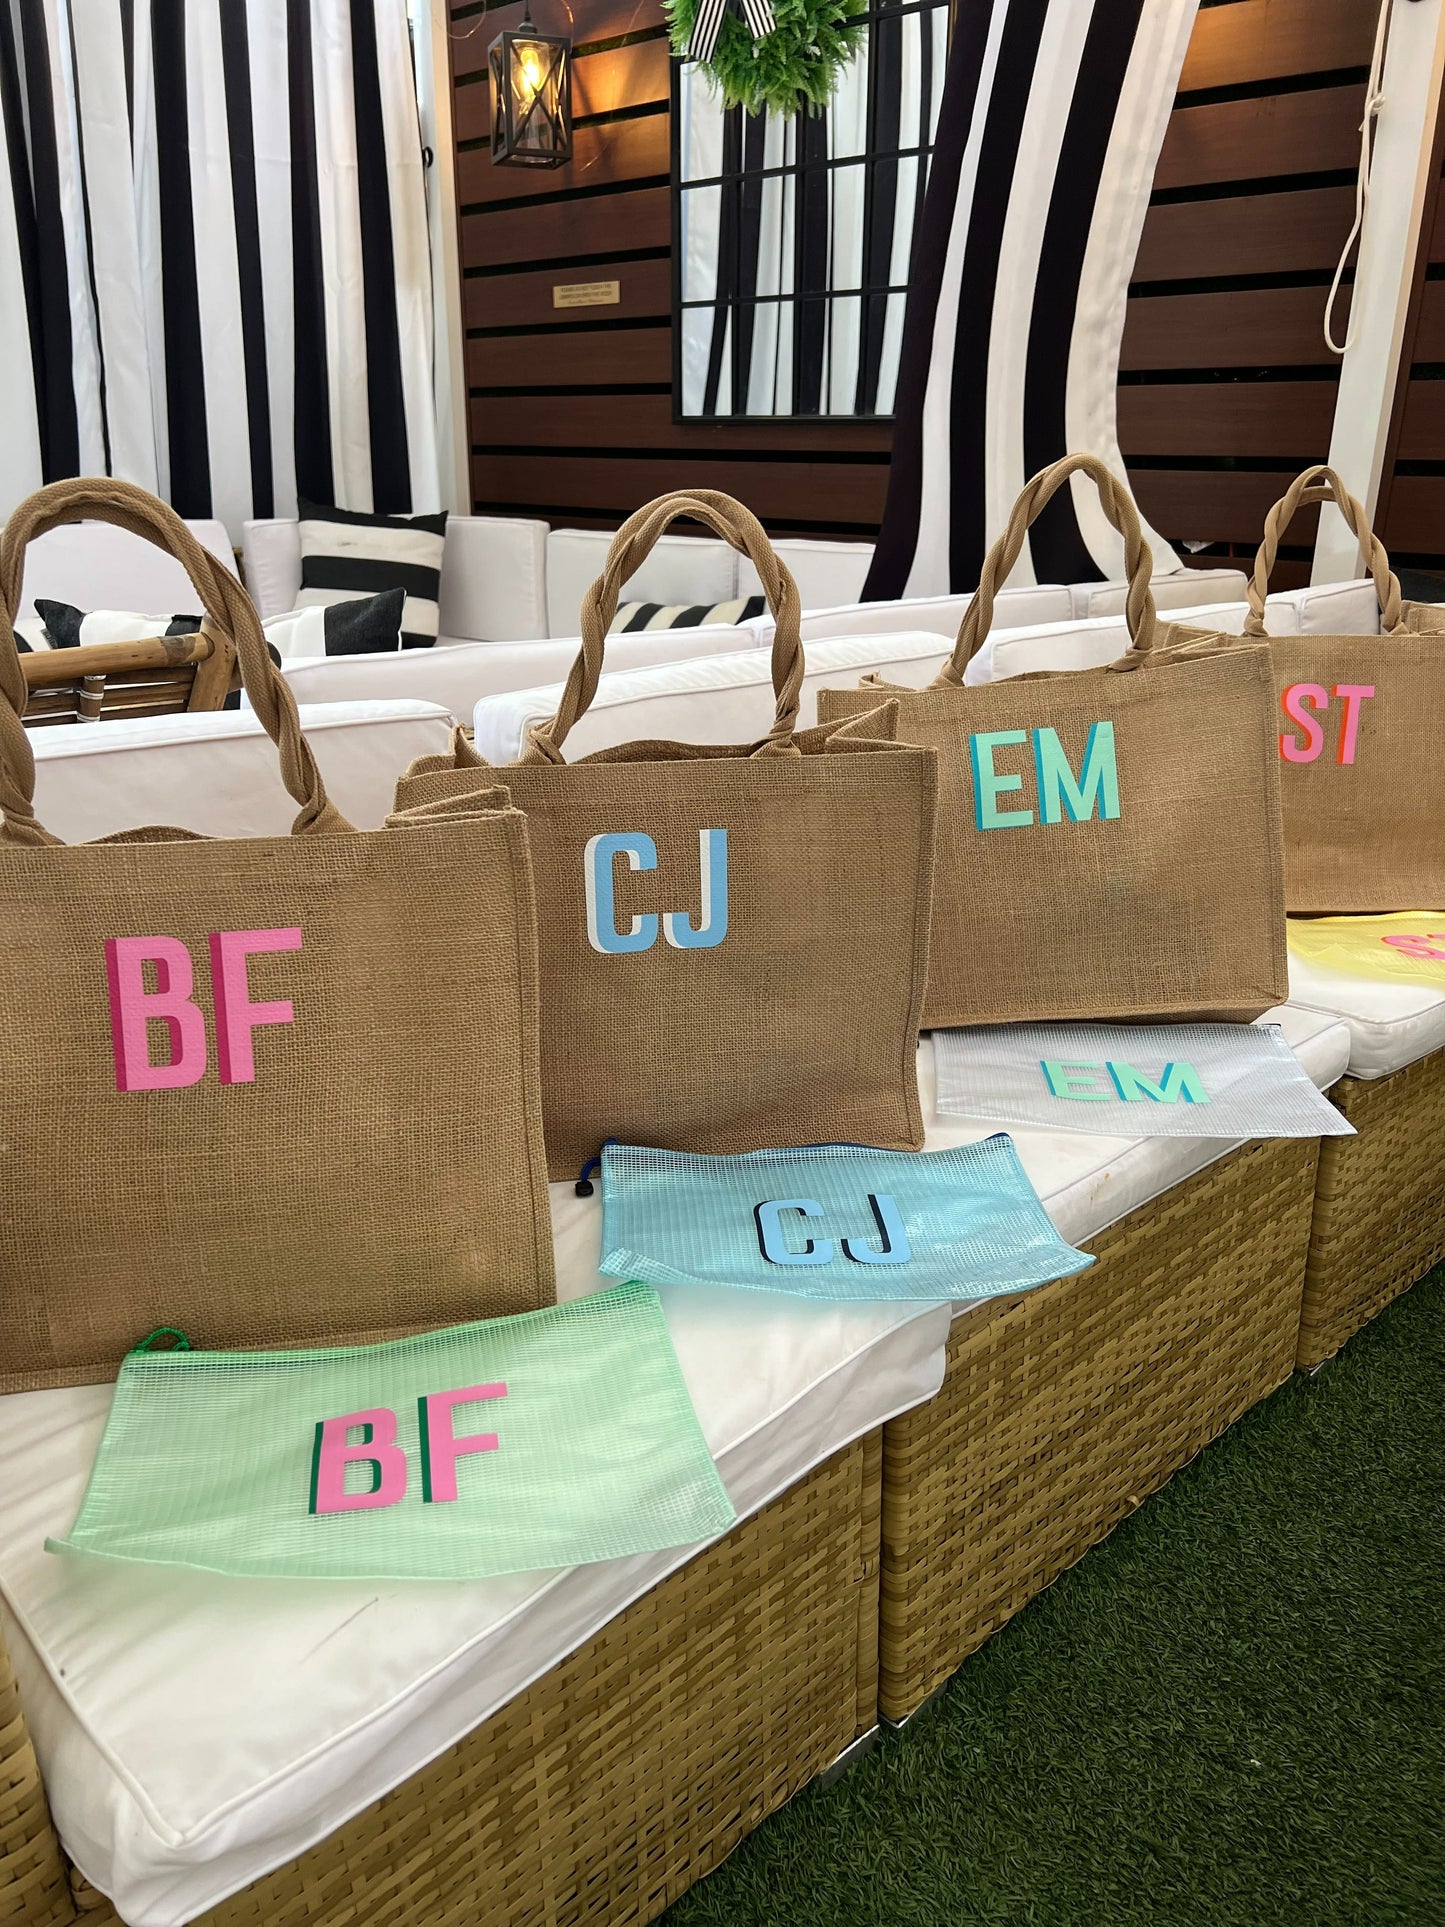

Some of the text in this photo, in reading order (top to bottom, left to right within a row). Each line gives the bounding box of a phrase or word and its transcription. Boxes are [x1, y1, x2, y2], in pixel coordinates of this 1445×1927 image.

[1279, 683, 1376, 765] ST
[969, 721, 1121, 831] EM
[584, 828, 729, 954] CJ
[1380, 933, 1445, 960] S
[104, 926, 303, 1092] BF
[1040, 1060, 1212, 1103] EM
[753, 1193, 912, 1266] CJ
[308, 1382, 508, 1515] BF
